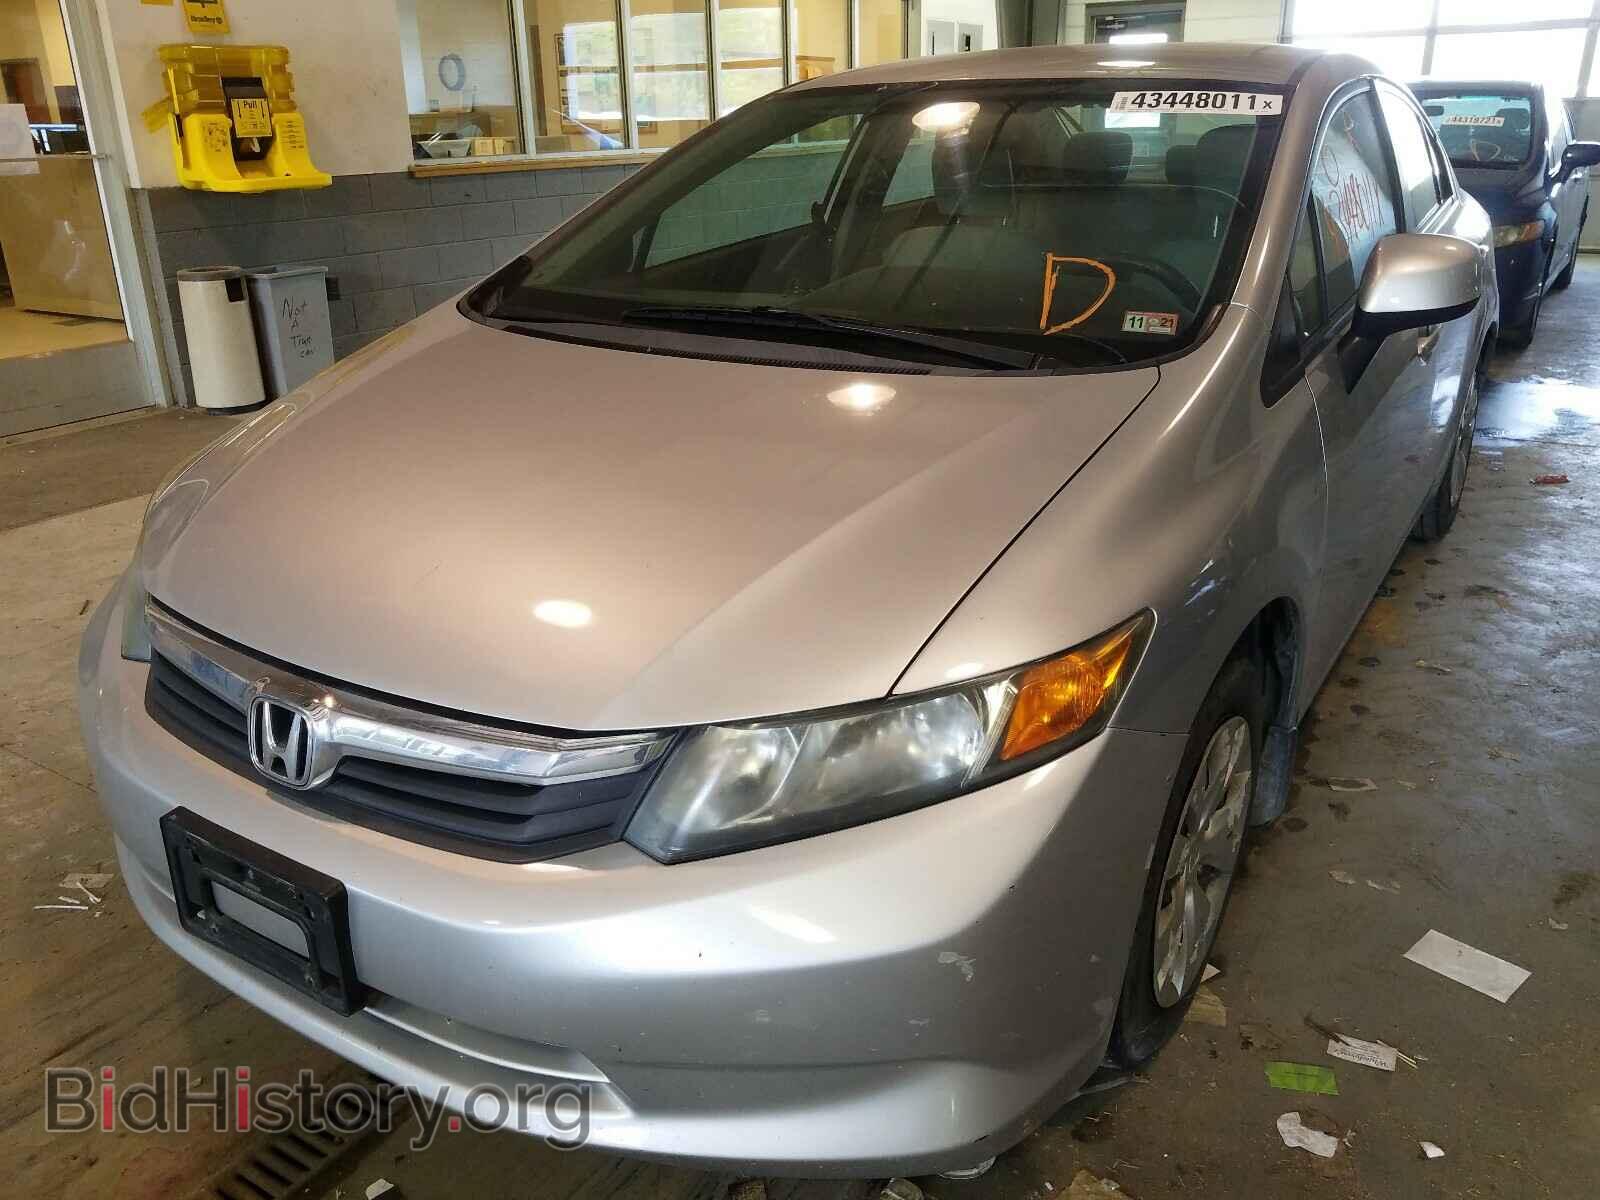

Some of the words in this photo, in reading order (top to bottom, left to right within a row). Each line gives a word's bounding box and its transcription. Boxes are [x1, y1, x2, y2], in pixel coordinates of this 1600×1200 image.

[243, 100, 258, 109] Pull
[1039, 252, 1117, 336] D
[282, 296, 308, 320] Not
[1129, 316, 1144, 329] 11
